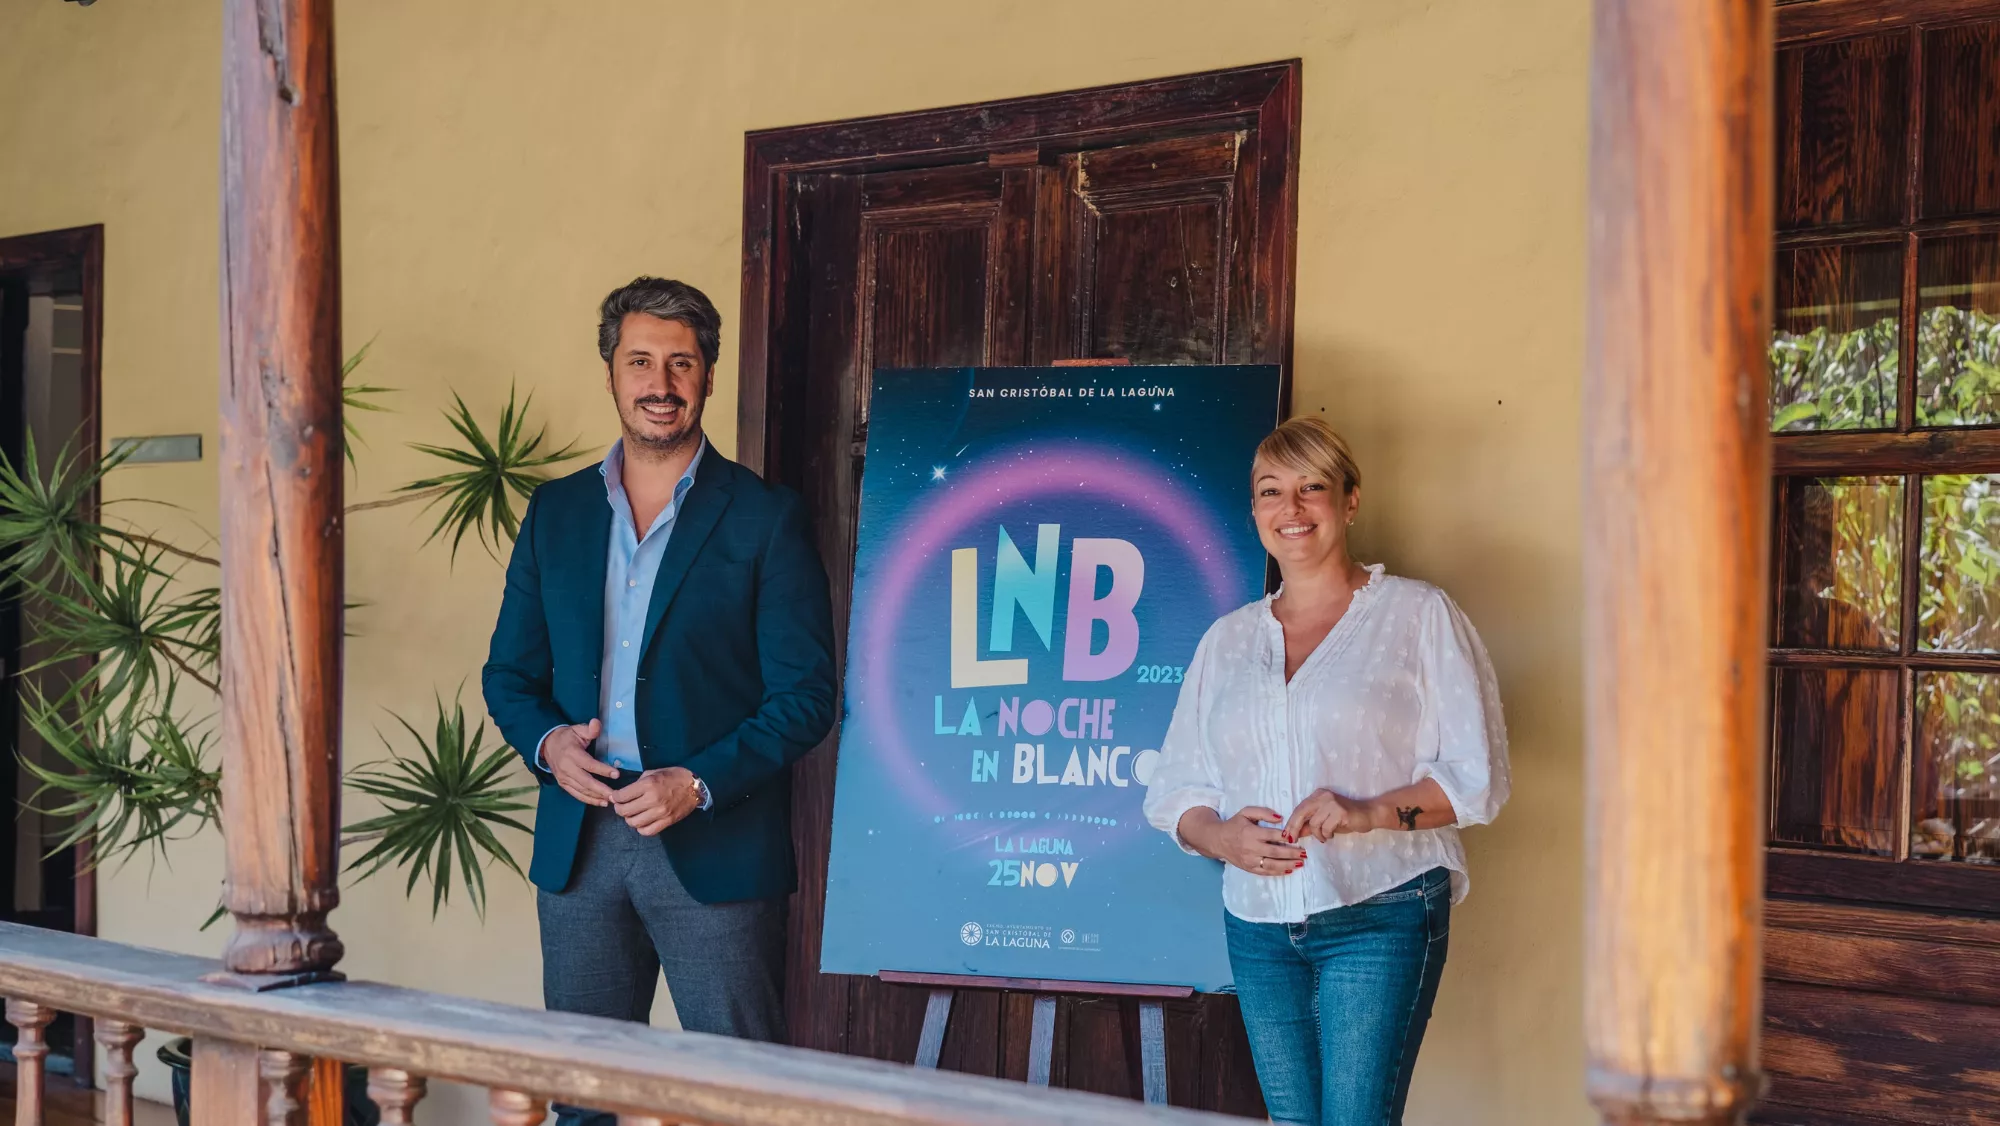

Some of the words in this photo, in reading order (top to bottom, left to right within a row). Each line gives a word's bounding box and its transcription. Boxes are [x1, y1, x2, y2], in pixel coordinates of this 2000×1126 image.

[968, 388, 995, 398] SAN
[999, 386, 1073, 398] CRISTÓBAL
[1078, 387, 1095, 397] DE
[1100, 387, 1115, 397] LA
[1121, 387, 1175, 397] LAGUNA
[951, 523, 1144, 688] LNB
[1136, 664, 1184, 684] 2023
[934, 695, 982, 736] LA
[997, 696, 1116, 739] NOCHE
[971, 750, 999, 783] EN
[995, 836, 1013, 852] LA
[1020, 836, 1073, 855] LAGUNA
[985, 936, 999, 946] LA
[1003, 937, 1050, 948] LAGUNA
